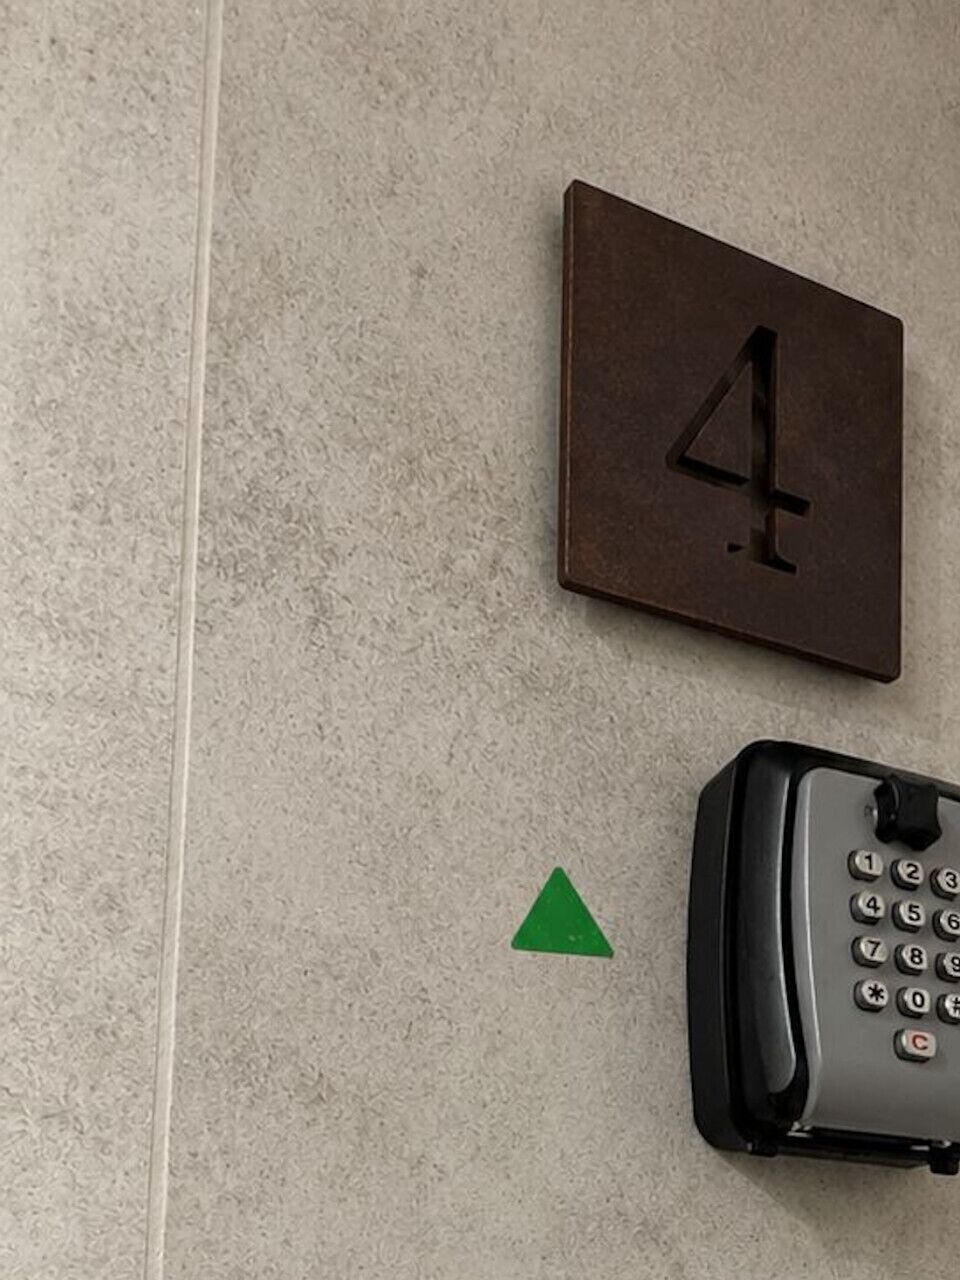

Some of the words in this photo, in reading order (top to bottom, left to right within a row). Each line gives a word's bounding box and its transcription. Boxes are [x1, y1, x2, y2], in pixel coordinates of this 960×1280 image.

[665, 324, 811, 576] 4
[864, 854, 873, 870] 1
[906, 863, 920, 880] 2
[945, 871, 958, 889] 3
[866, 896, 880, 913] 4
[908, 904, 921, 922] 5
[947, 914, 960, 930] 6
[867, 940, 881, 957] 7
[910, 948, 923, 965] 8
[912, 1034, 928, 1051] C
